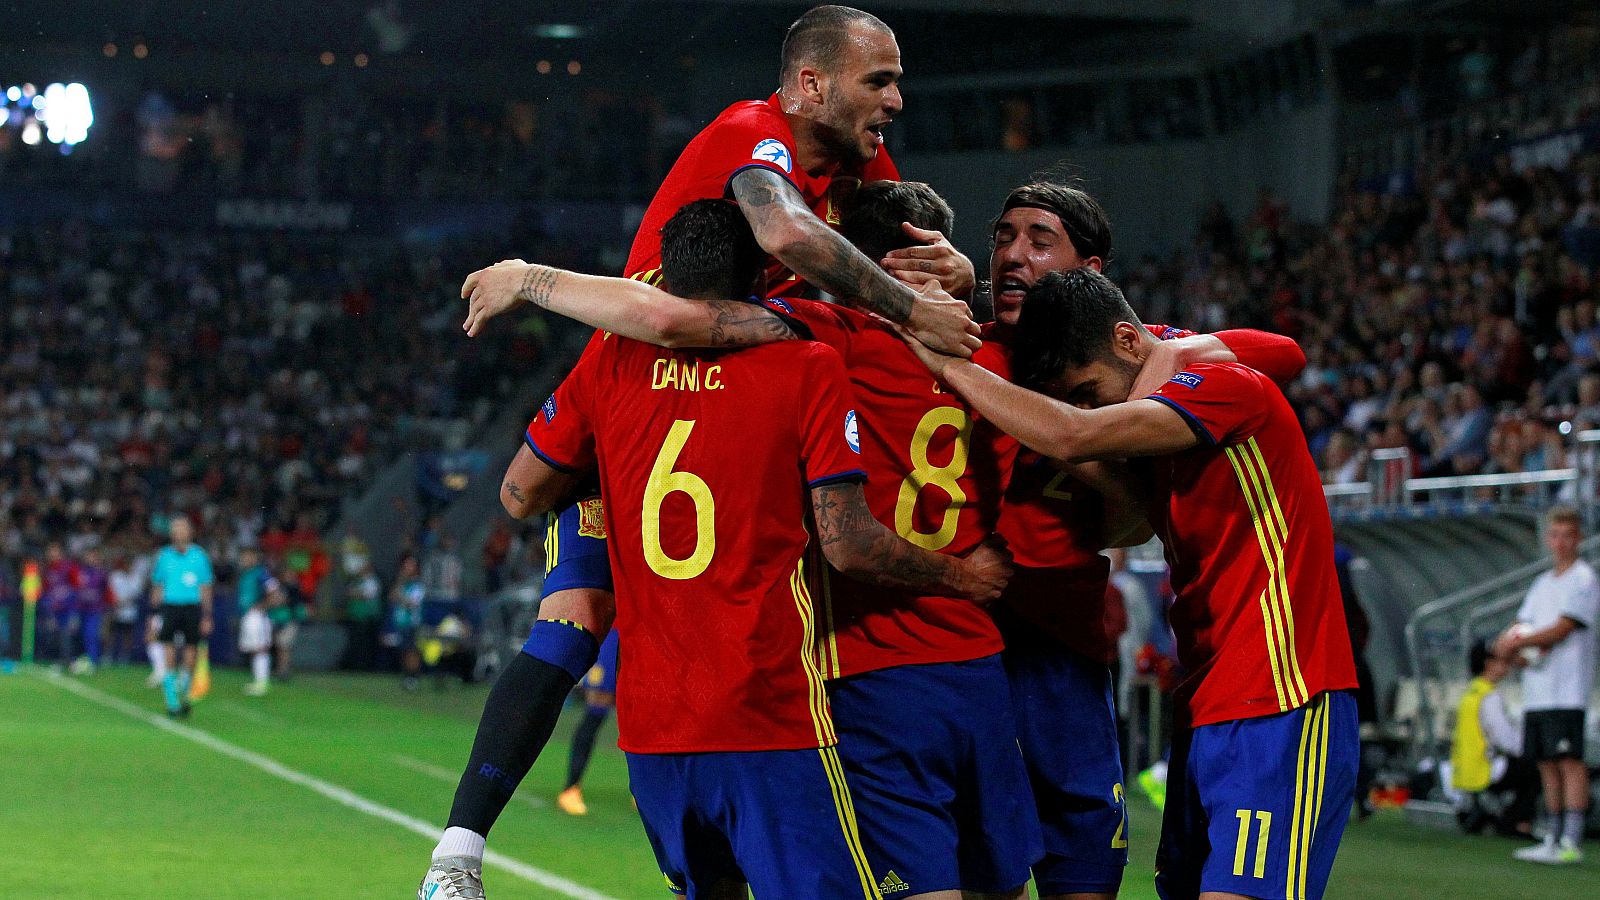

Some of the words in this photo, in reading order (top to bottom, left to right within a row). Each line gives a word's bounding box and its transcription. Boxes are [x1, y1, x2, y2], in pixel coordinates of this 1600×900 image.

[652, 358, 700, 392] DANI
[704, 365, 725, 390] C.
[641, 419, 716, 580] 6
[895, 406, 974, 551] 8
[1111, 783, 1127, 848] 2
[1233, 809, 1272, 879] 11
[878, 882, 910, 895] adidas
